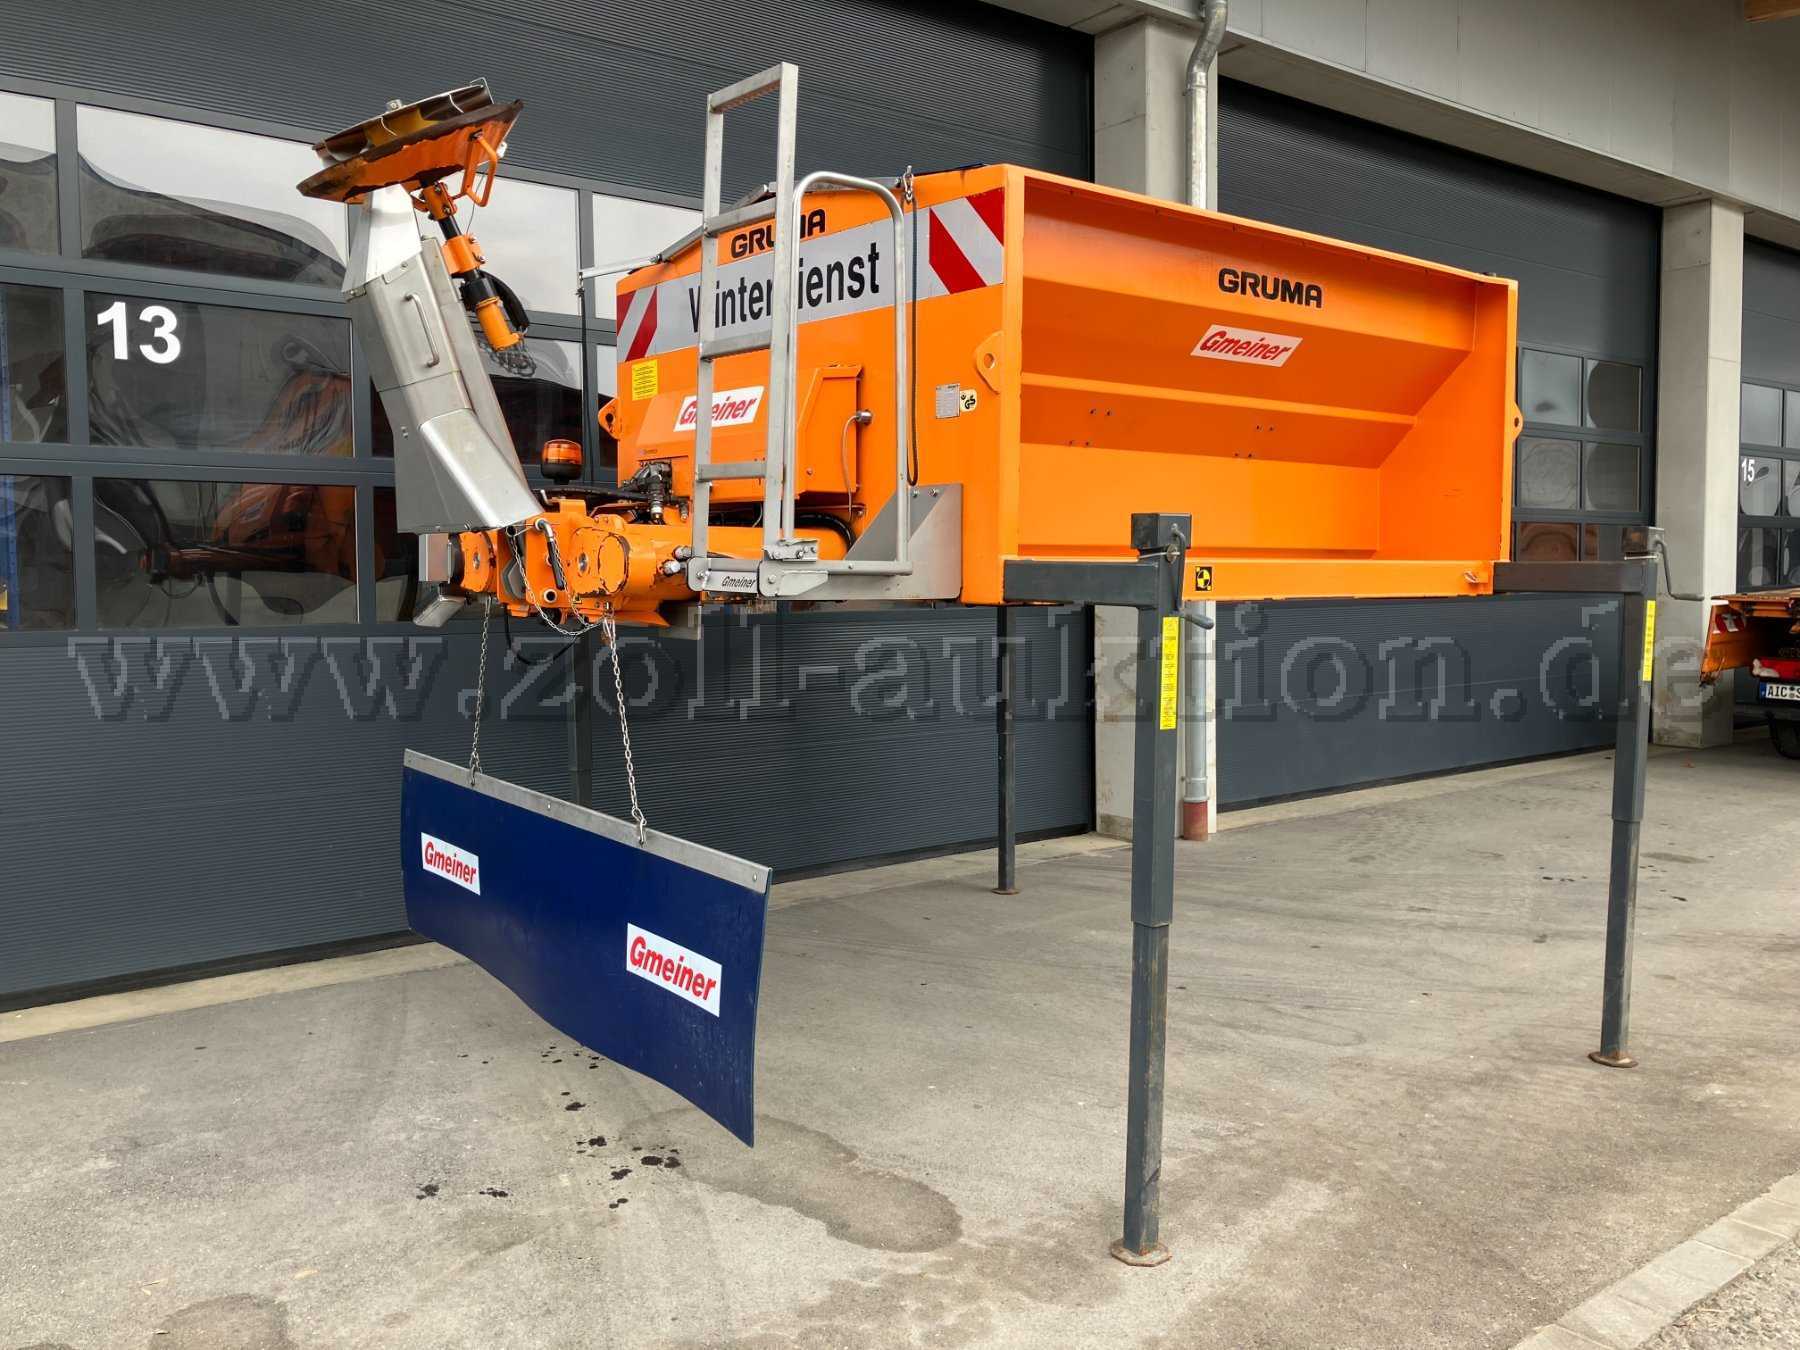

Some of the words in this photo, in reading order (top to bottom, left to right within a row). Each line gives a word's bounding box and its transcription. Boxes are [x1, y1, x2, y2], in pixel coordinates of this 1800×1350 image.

[1218, 267, 1322, 308] GRUMA
[97, 301, 181, 365] 13
[1199, 330, 1292, 361] Gmeiner
[680, 396, 758, 425] Geiner
[1741, 457, 1755, 482] 15
[721, 575, 757, 589] Gmeiner
[1767, 685, 1788, 698] AIC
[424, 841, 477, 885] Gmeiner
[629, 936, 717, 1001] Gmeiner
